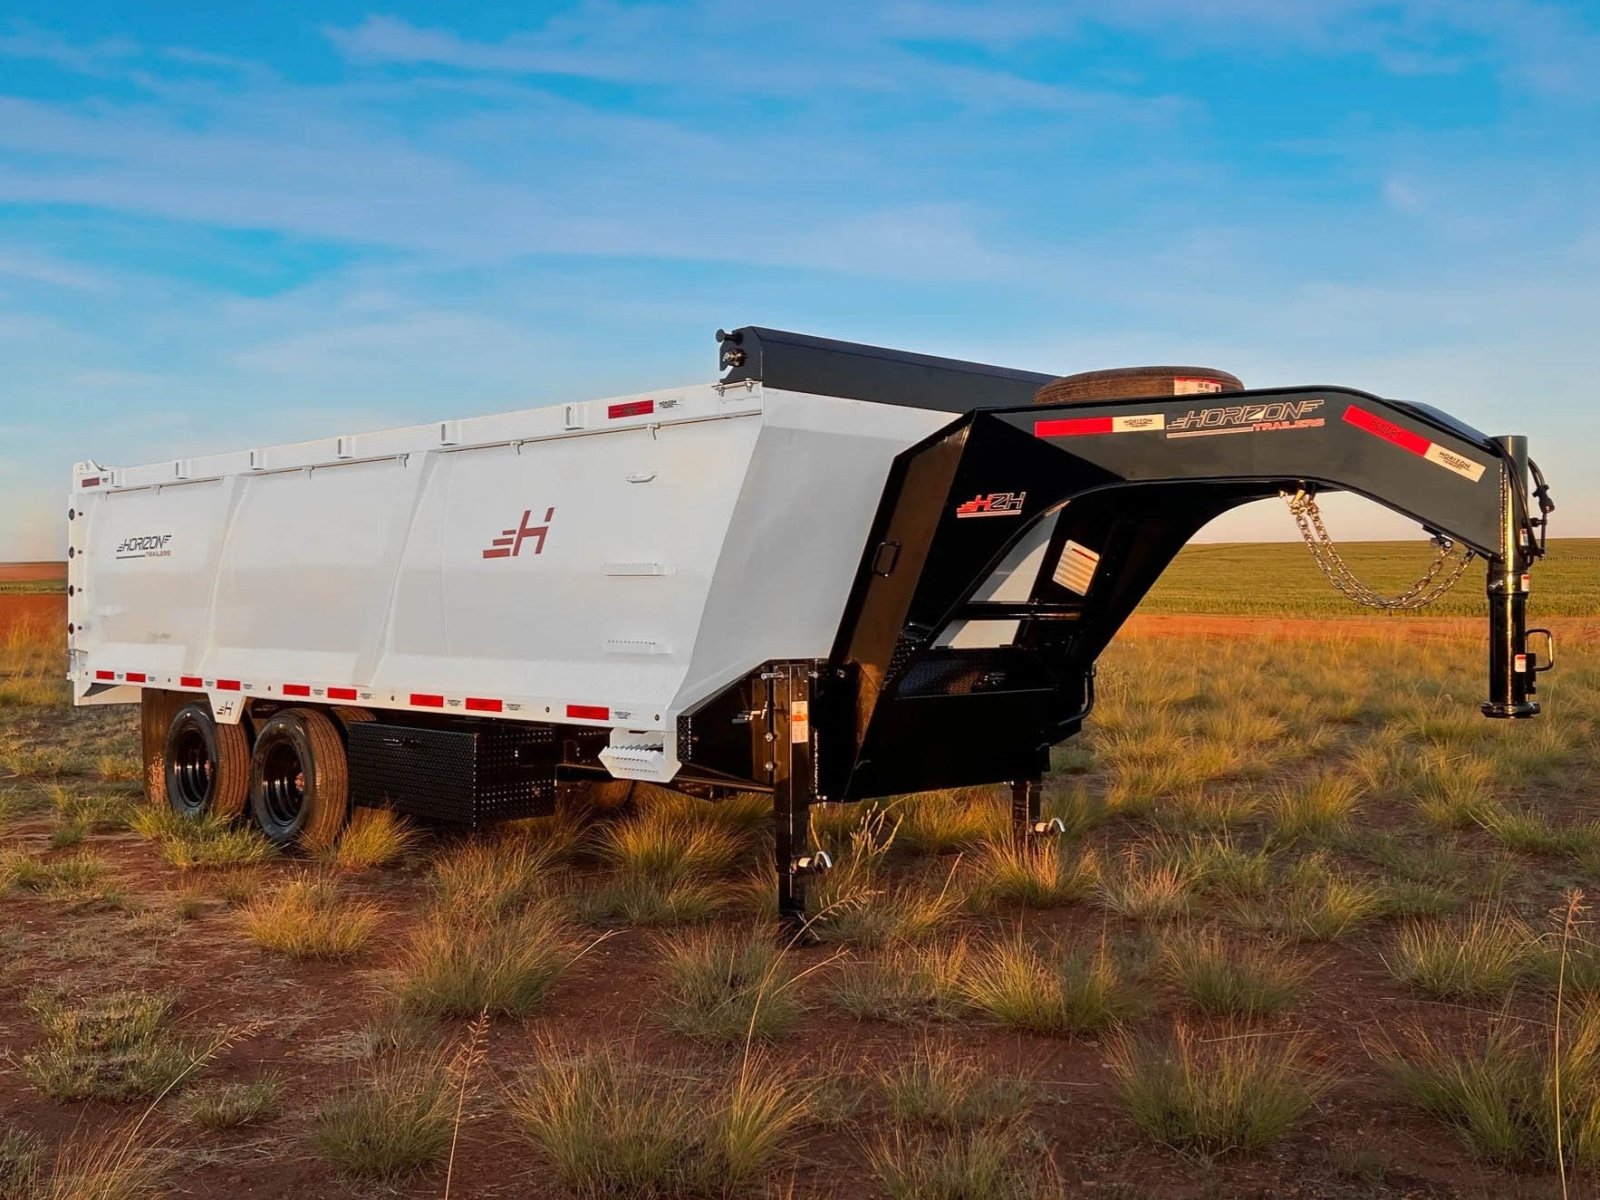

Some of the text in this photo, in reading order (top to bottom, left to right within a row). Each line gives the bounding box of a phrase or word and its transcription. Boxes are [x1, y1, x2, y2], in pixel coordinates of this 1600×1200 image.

[1182, 400, 1307, 428] HORIZON
[1252, 418, 1325, 431] TRAILERS
[1439, 451, 1471, 469] HORIZON
[121, 535, 167, 551] HORIZON
